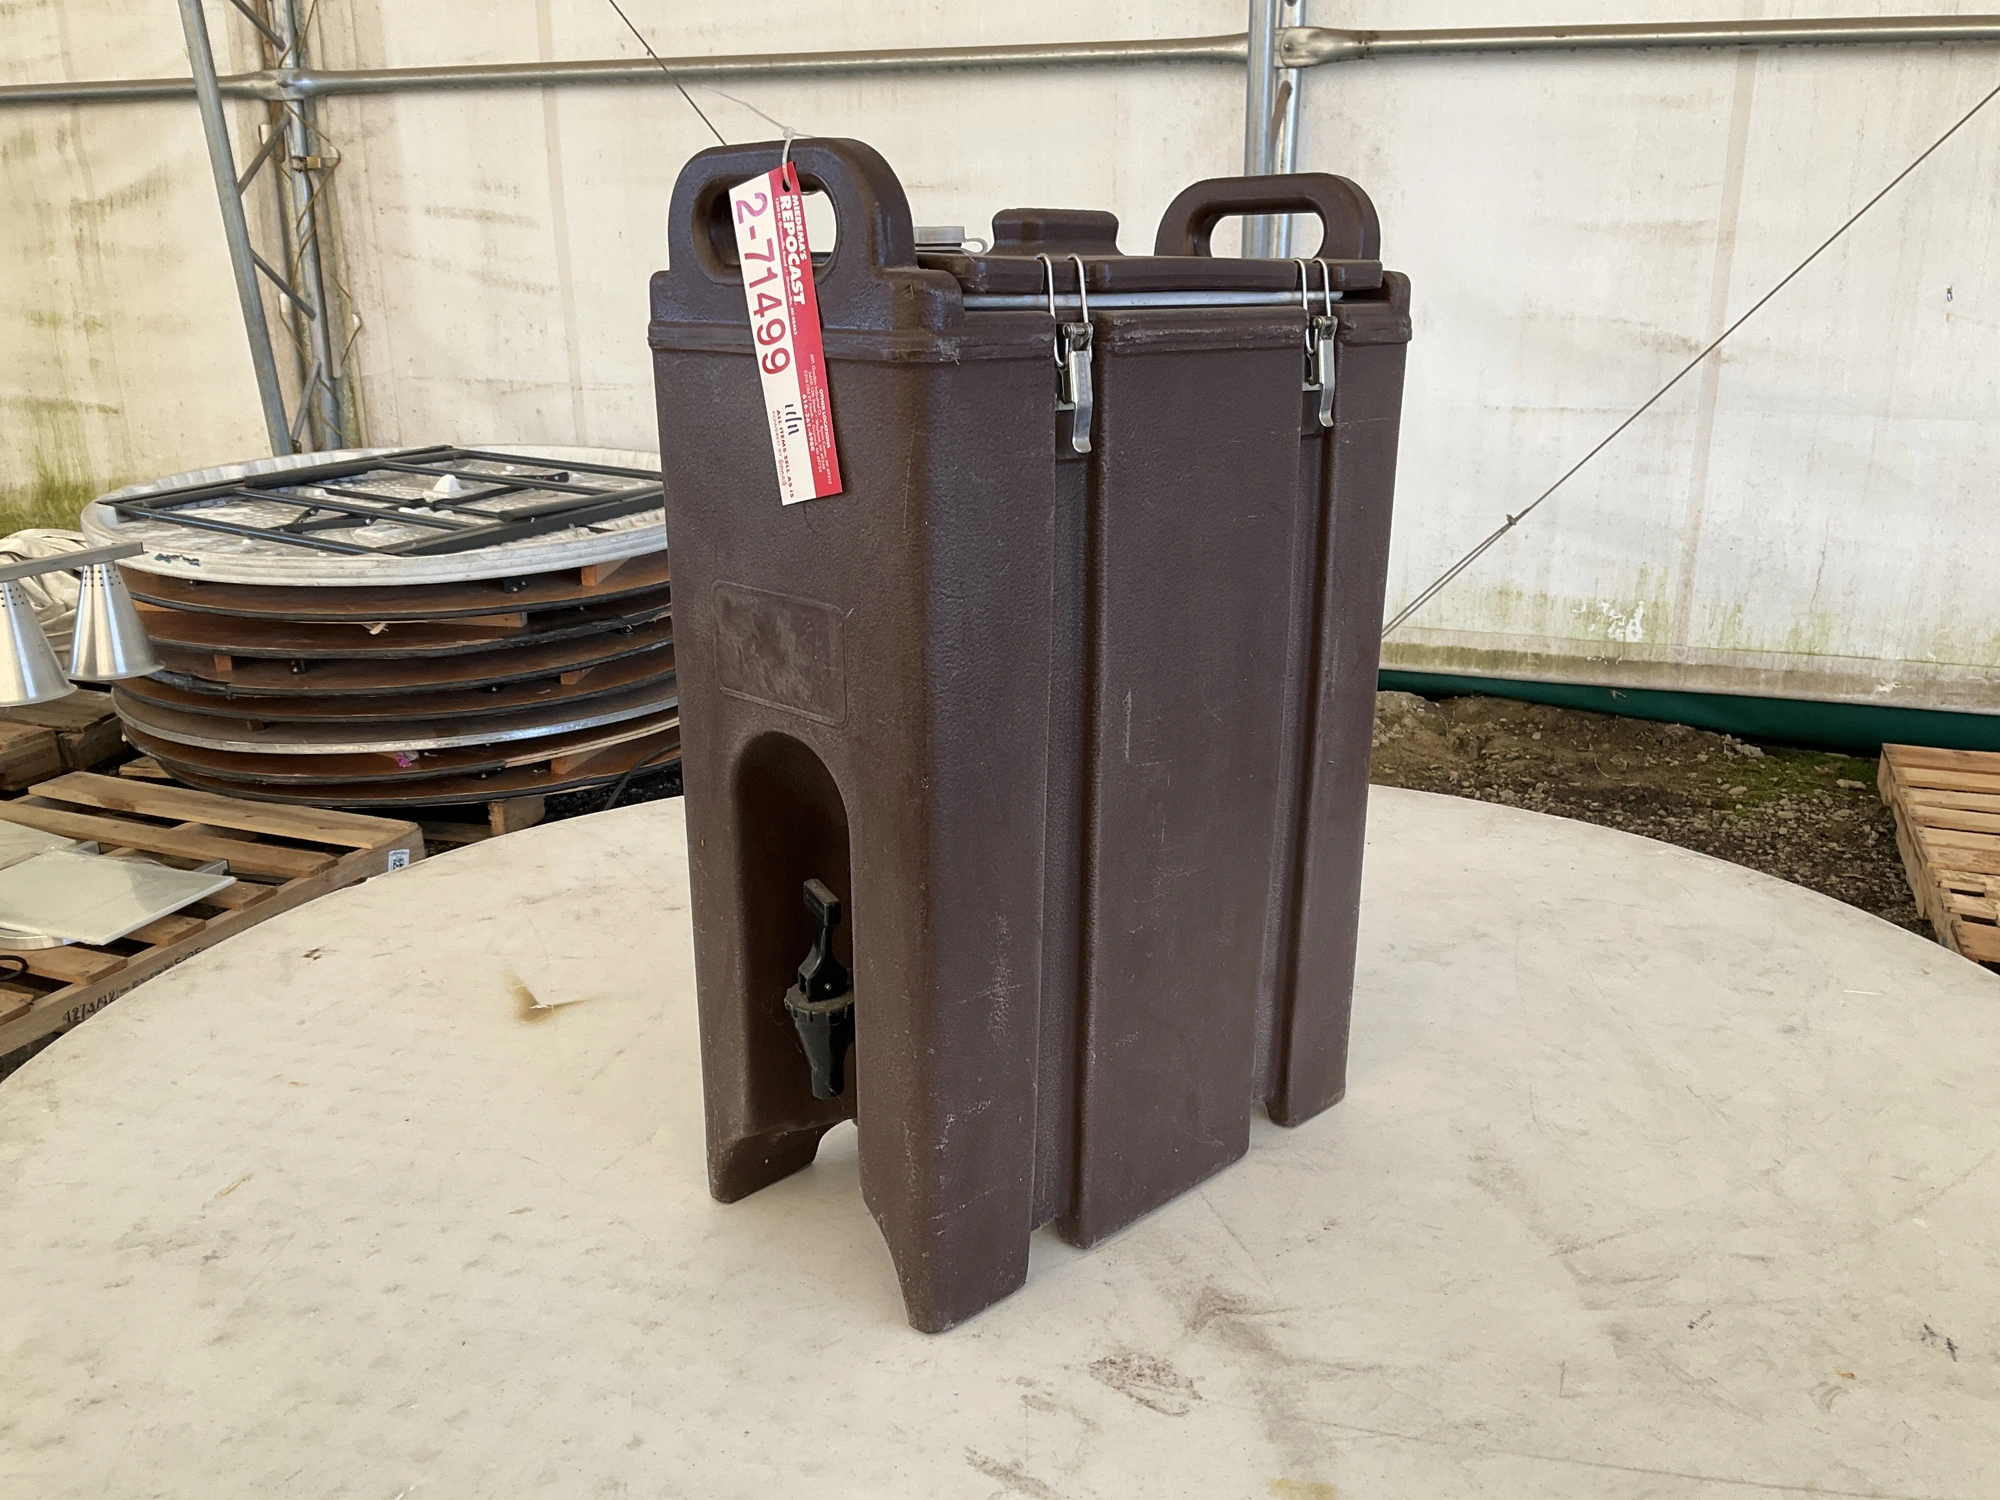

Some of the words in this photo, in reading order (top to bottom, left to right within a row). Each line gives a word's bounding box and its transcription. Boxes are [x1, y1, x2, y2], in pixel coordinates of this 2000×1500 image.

[779, 195, 805, 305] REPOCAST
[791, 194, 807, 260] MIEDEMA'S
[736, 192, 791, 375] 2-71499
[771, 410, 780, 446] POWERED
[777, 448, 782, 457] BY
[801, 393, 815, 451] 616-261-4988
[821, 411, 831, 448] LOCATIONS
[778, 427, 786, 452] ITEMS
[786, 475, 792, 487] AS
[789, 489, 794, 498] IS
